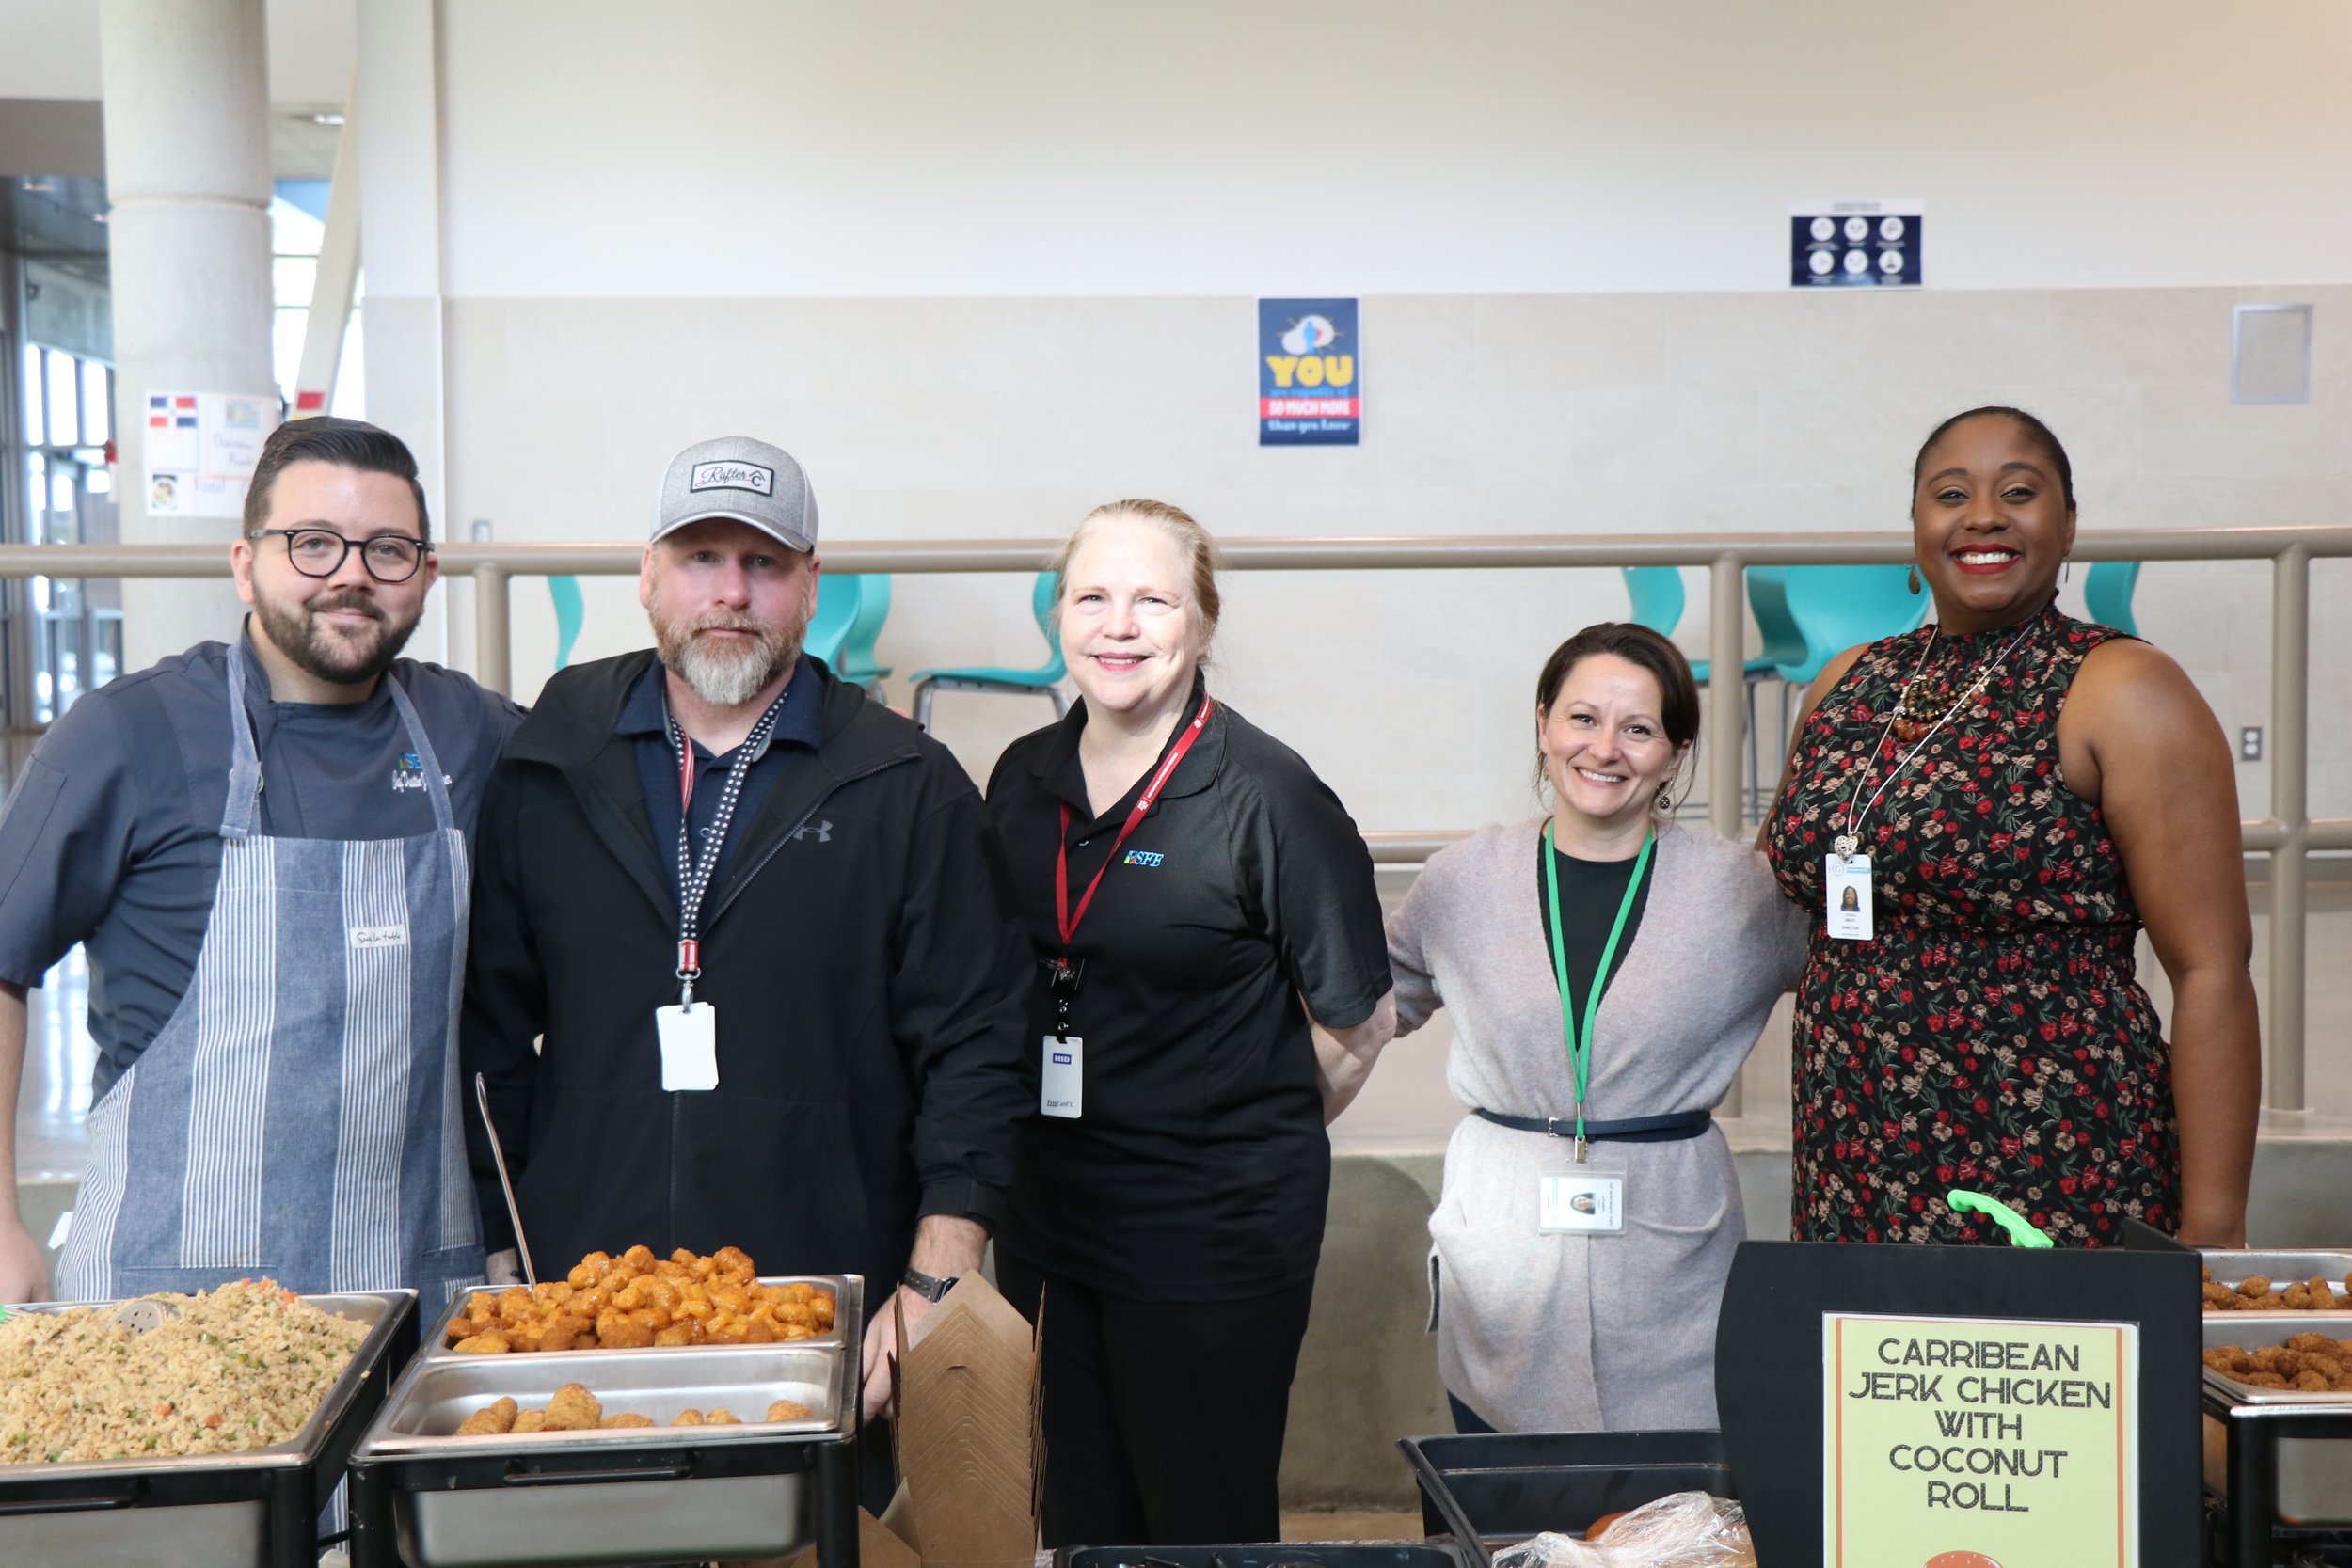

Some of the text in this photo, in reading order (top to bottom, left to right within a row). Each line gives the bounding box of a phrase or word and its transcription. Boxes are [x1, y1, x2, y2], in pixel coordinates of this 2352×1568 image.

[1265, 356, 1354, 387] YOU
[1269, 399, 1351, 416] SO MUCH MORE
[1134, 851, 1165, 867] SFE
[1054, 1054, 1071, 1063] HID
[1878, 1338, 2079, 1371] CARRIBEAN
[1848, 1371, 2110, 1409] JERK CHICKEN
[1934, 1409, 2022, 1440] WITH
[1889, 1444, 2068, 1478] COCONUT
[1927, 1480, 2029, 1512] ROLL
